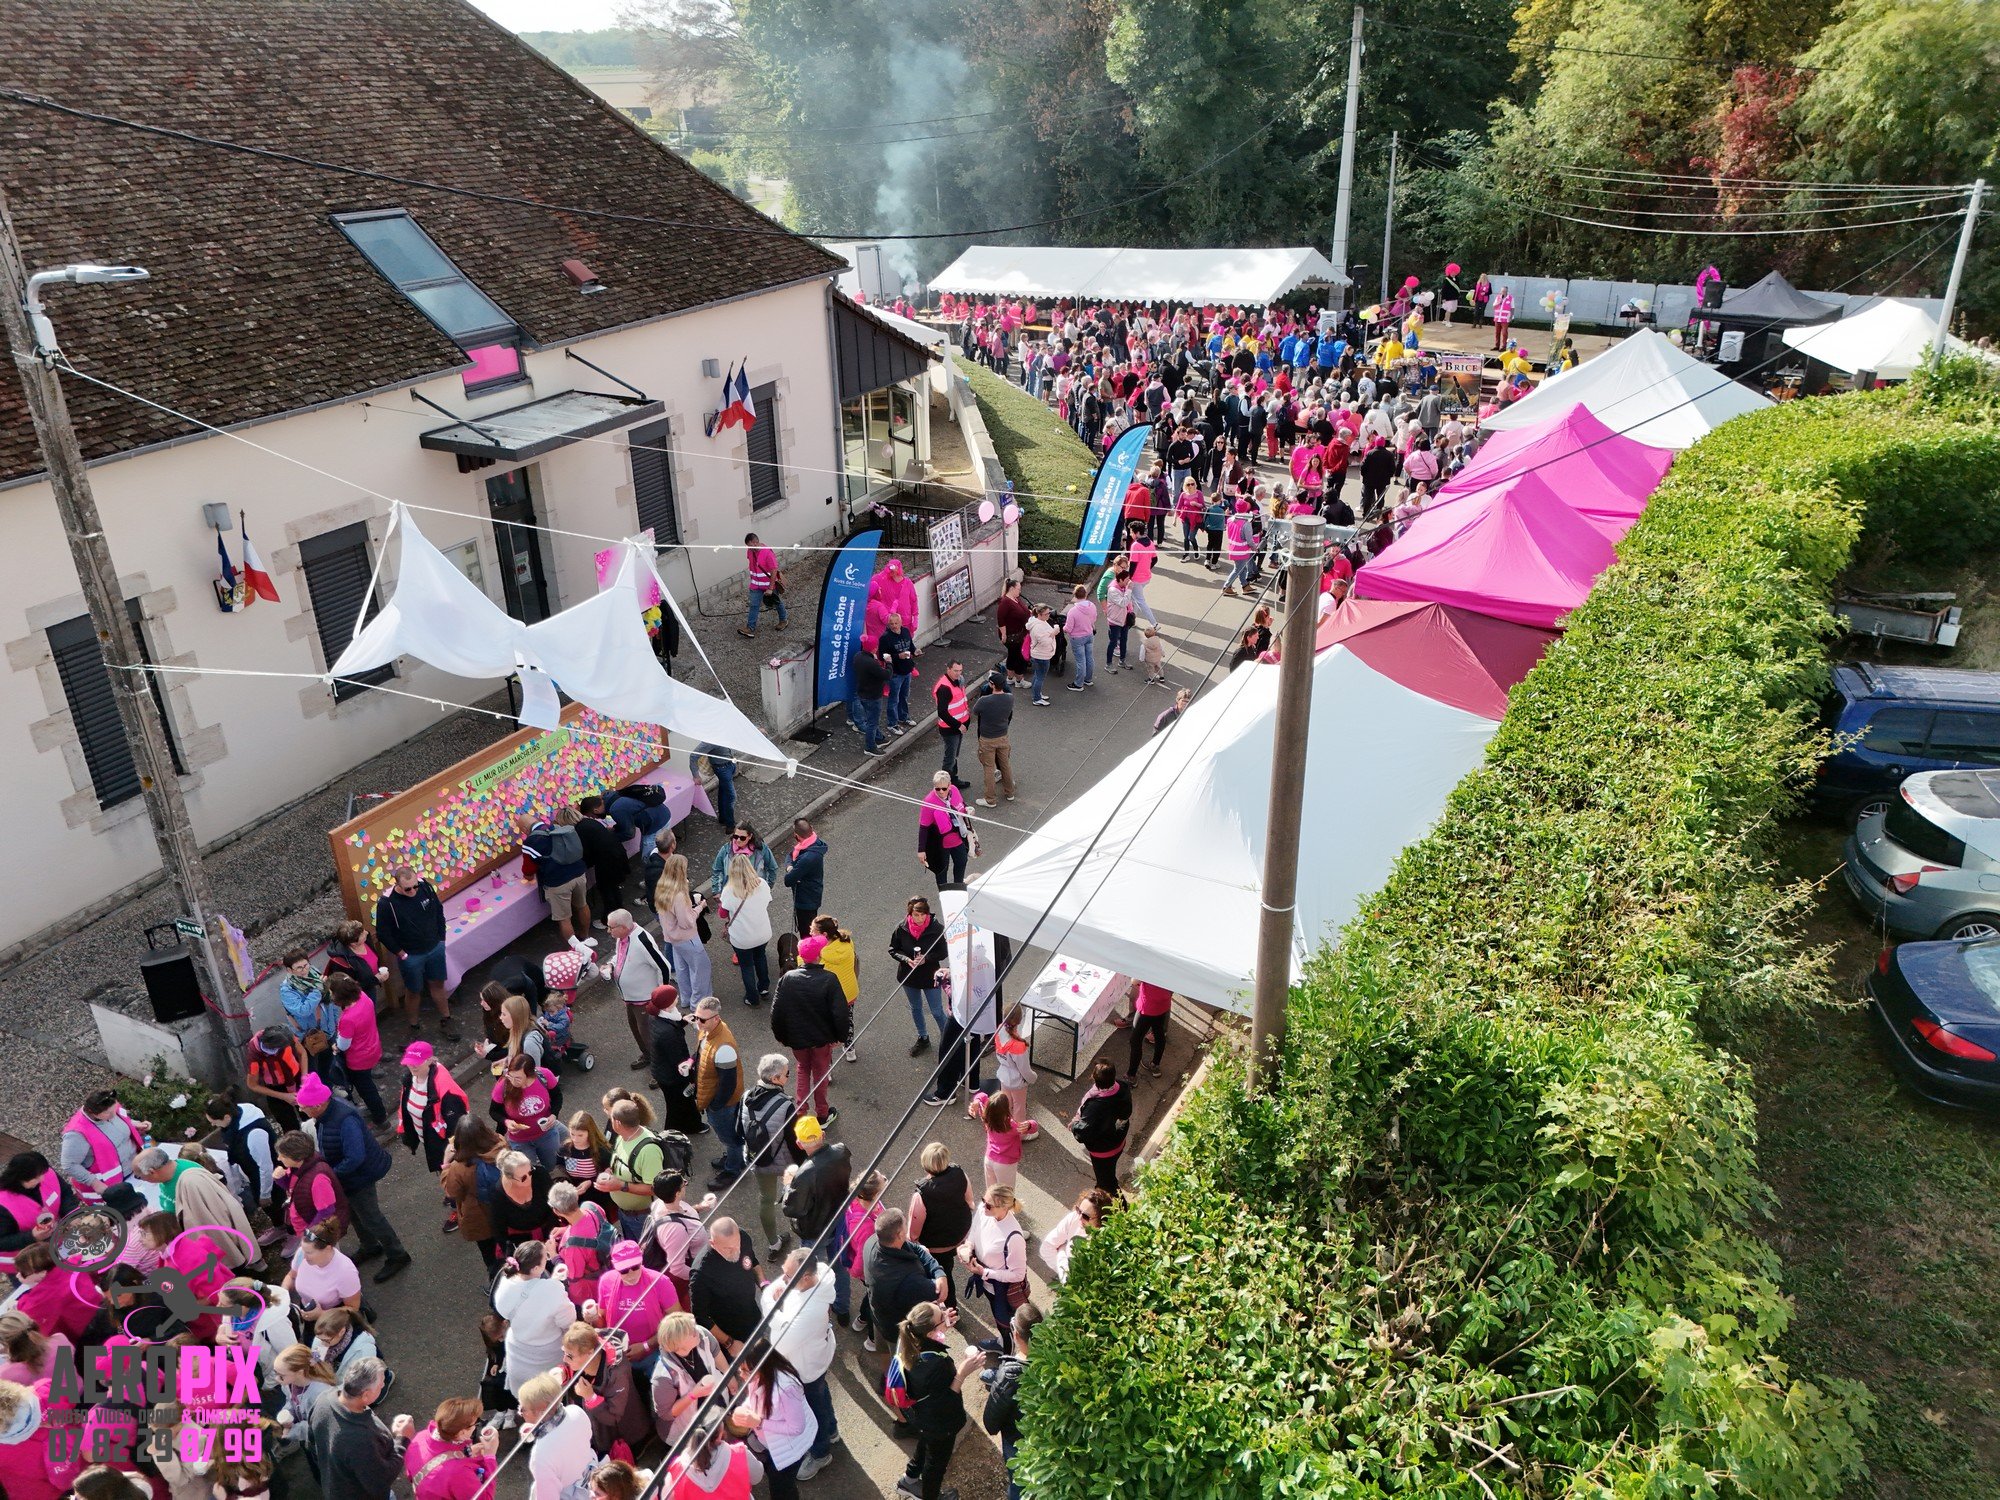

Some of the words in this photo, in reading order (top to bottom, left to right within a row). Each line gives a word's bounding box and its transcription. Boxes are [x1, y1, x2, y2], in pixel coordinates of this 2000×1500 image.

[1445, 361, 1478, 372] BRICE
[1101, 476, 1116, 505] Saône
[1097, 507, 1106, 518] de
[1089, 519, 1102, 545] Rives
[833, 596, 847, 632] Saône
[845, 599, 856, 632] Communes
[831, 634, 842, 648] de
[844, 632, 850, 640] de
[829, 651, 840, 681] Rives
[840, 641, 850, 678] Communauté
[475, 774, 482, 787] LE
[483, 769, 497, 781] MUR
[497, 762, 509, 774] DES
[509, 743, 541, 767] MARCHEURS
